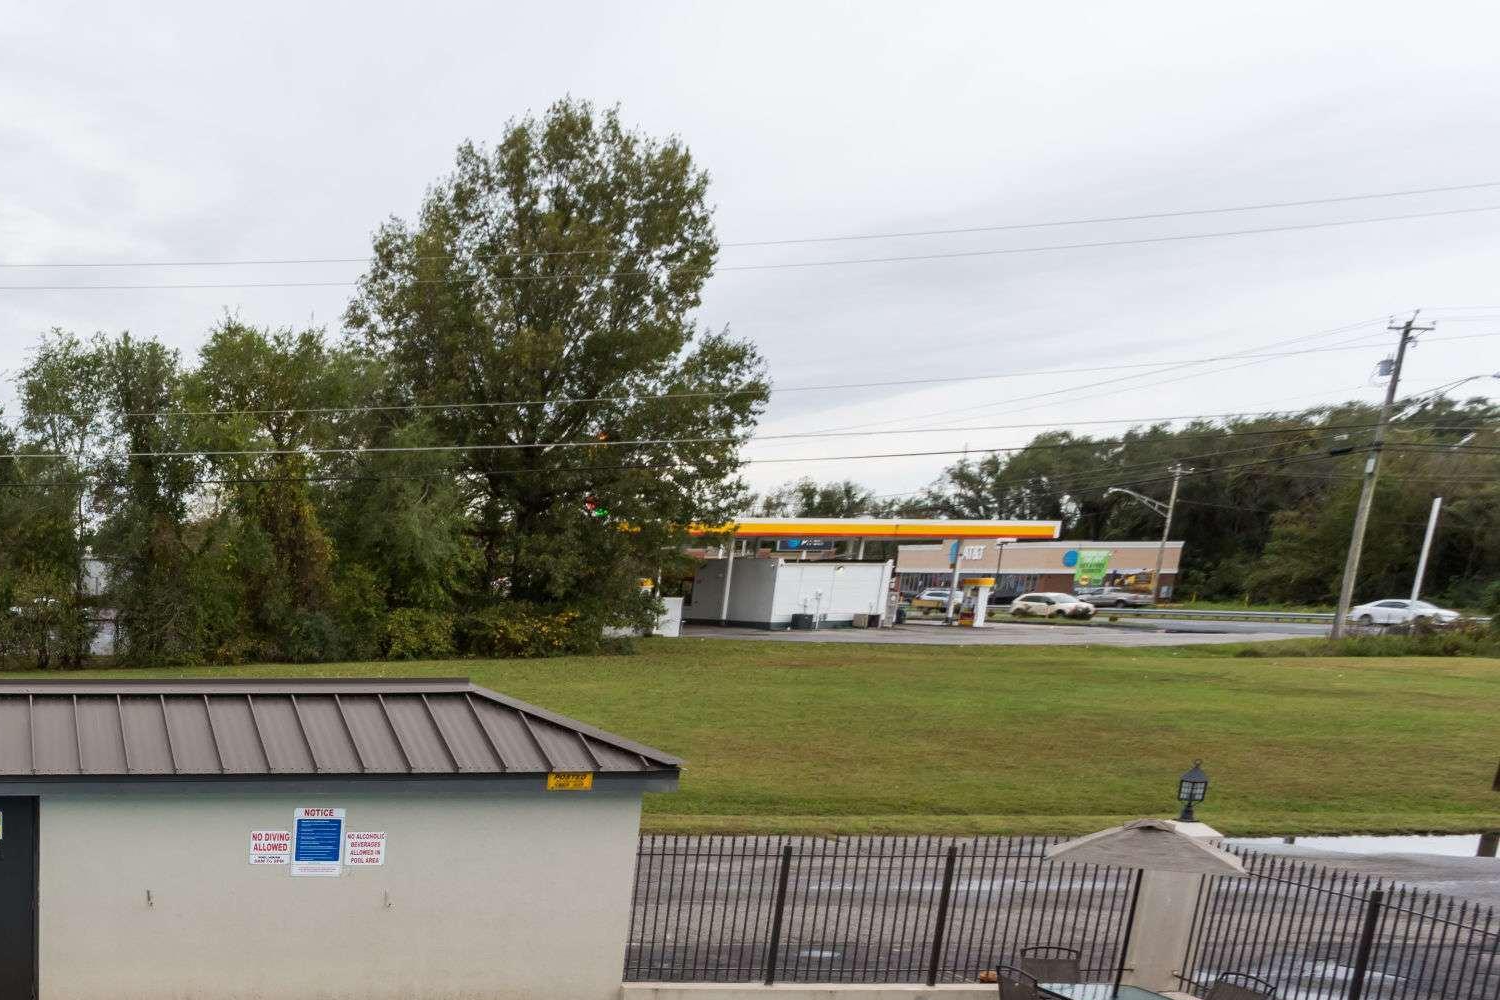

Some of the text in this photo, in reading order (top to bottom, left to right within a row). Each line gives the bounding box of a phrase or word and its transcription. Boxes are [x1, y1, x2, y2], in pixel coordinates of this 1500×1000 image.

[304, 809, 334, 817] NOTICE
[252, 833, 290, 841] NO DIVING
[253, 843, 288, 851] ALLOWED
